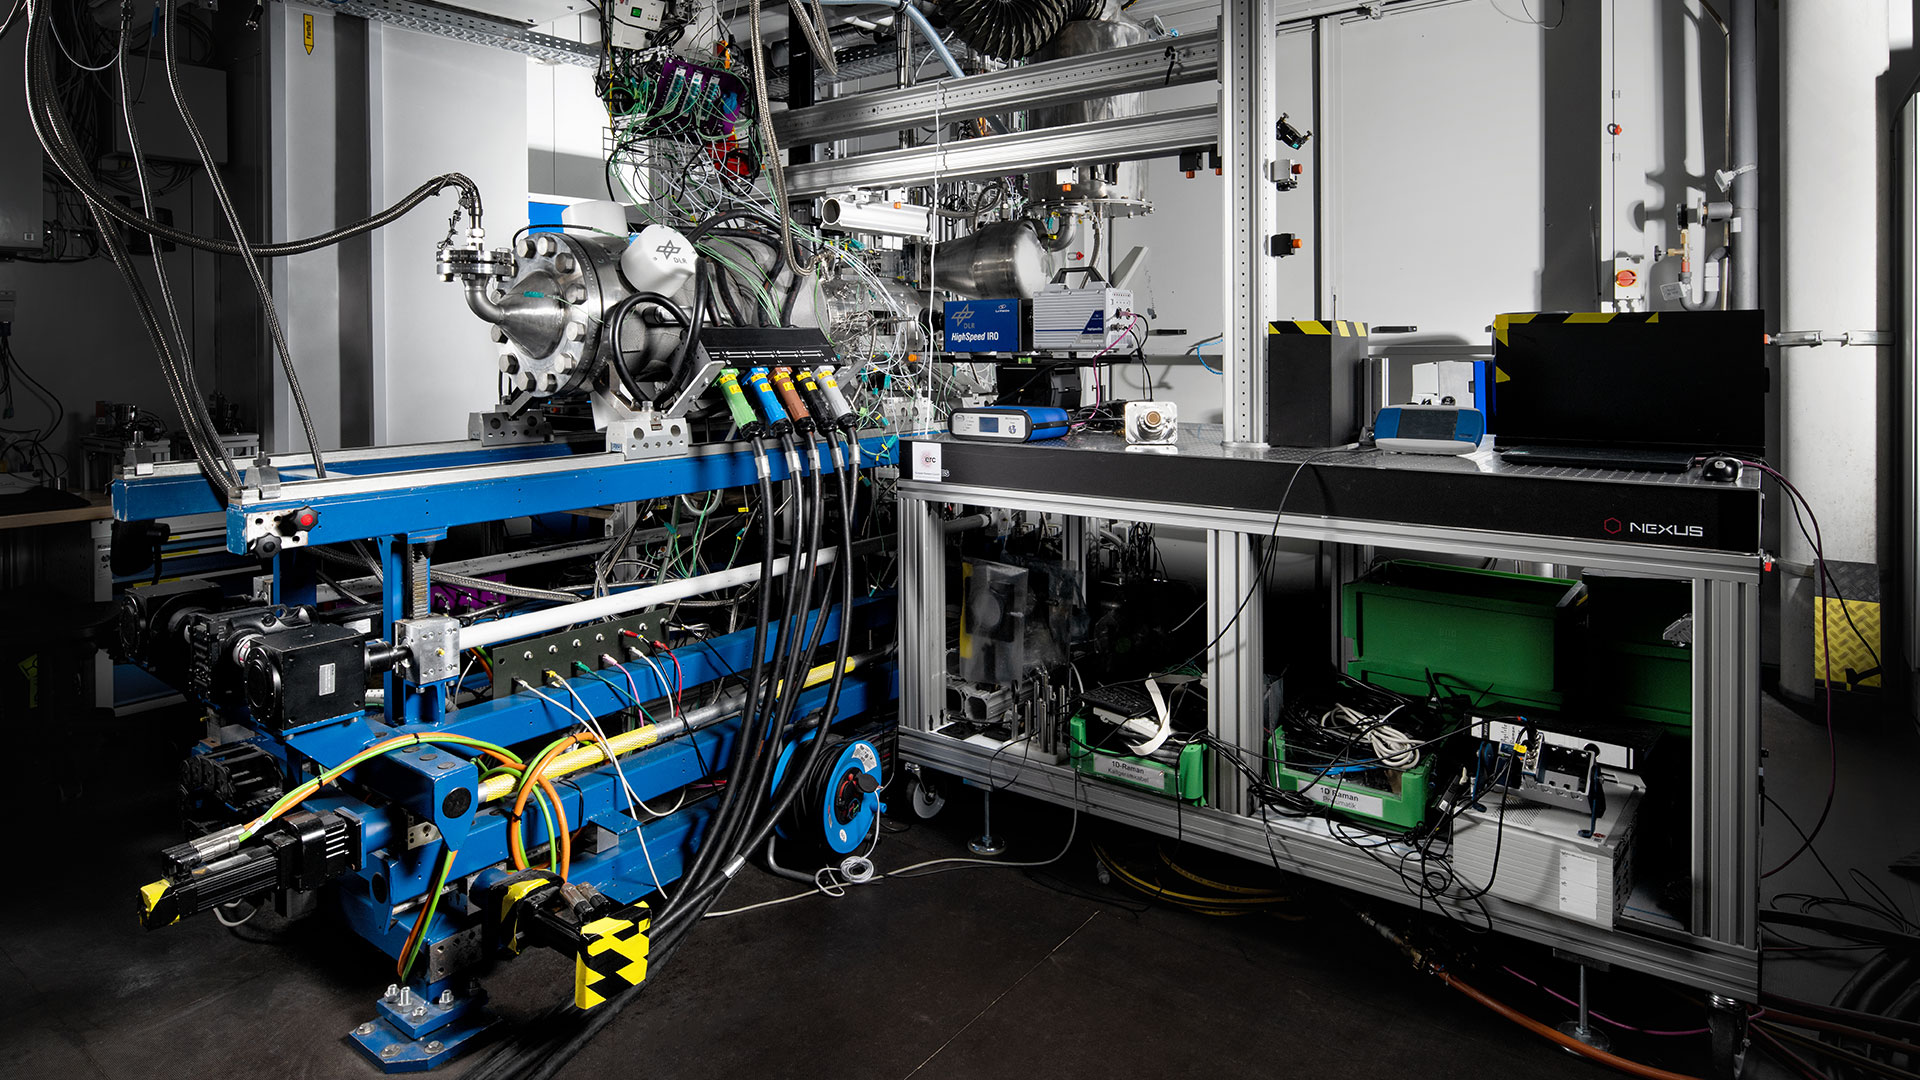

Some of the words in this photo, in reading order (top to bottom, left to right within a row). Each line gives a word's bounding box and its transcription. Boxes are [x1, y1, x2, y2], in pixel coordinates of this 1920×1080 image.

[951, 332, 986, 342] HighSpeed
[987, 331, 999, 341] IRO
[925, 456, 937, 464] erc
[1629, 521, 1704, 537] NEXUS
[1111, 760, 1145, 774] 1D-Raman
[1320, 787, 1330, 795] 1D
